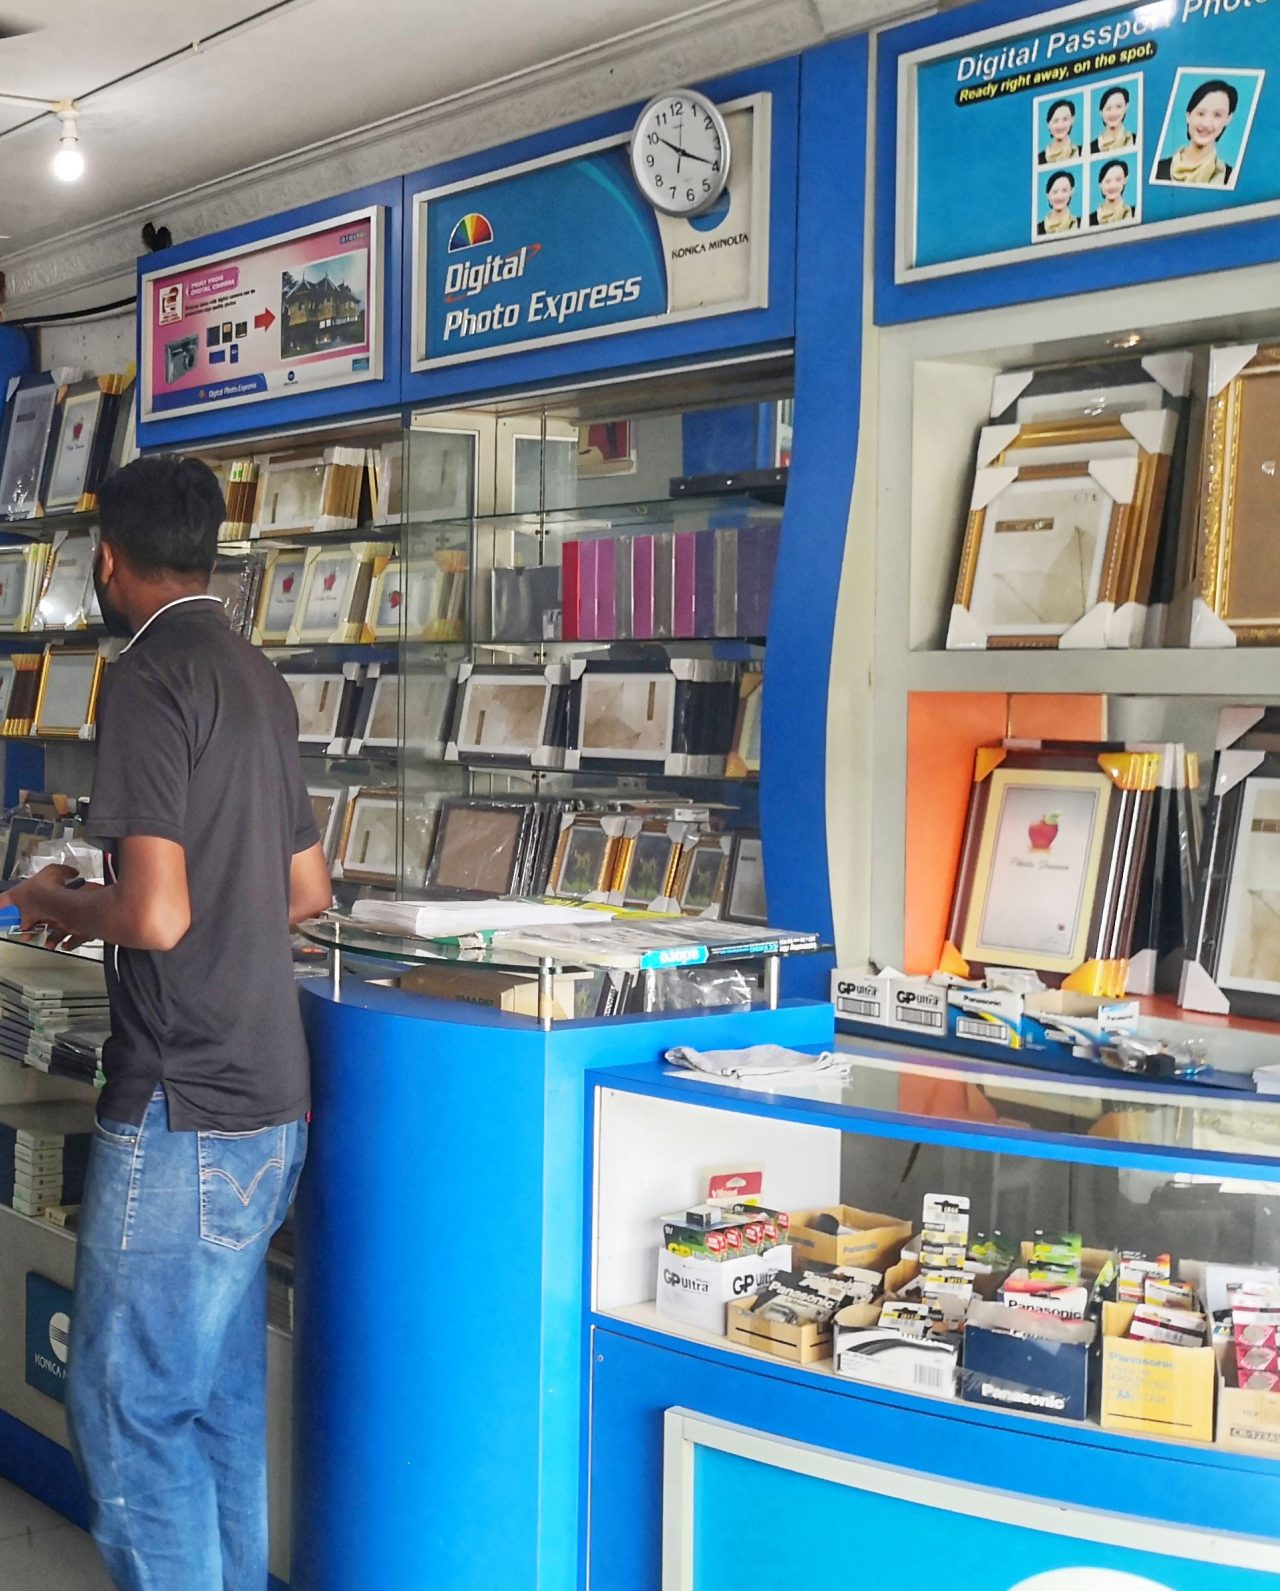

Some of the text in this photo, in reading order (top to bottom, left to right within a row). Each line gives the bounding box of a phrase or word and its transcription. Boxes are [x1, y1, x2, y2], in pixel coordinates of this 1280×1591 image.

[957, 0, 1270, 82] Digital Passpo Pho
[959, 42, 1154, 103] Ready right away, on the spot.
[669, 101, 683, 116] 12
[691, 104, 697, 117] 1
[656, 113, 667, 126] 11
[704, 115, 714, 130] 2
[647, 132, 658, 146] 10
[646, 154, 655, 167] 9
[711, 160, 720, 172] 4
[654, 174, 663, 187] 8
[702, 179, 711, 192] 5
[669, 186, 677, 199] 7
[686, 188, 695, 202] 6
[671, 233, 750, 260] KONICA MINOLTA
[444, 246, 528, 296] Digital
[443, 276, 642, 341] Photo Express
[837, 981, 856, 995] GP
[896, 990, 916, 1004] GP
[663, 1268, 709, 1292] GP Ultra
[733, 1274, 754, 1295] GP
[981, 1383, 1065, 1410] Panasonic
